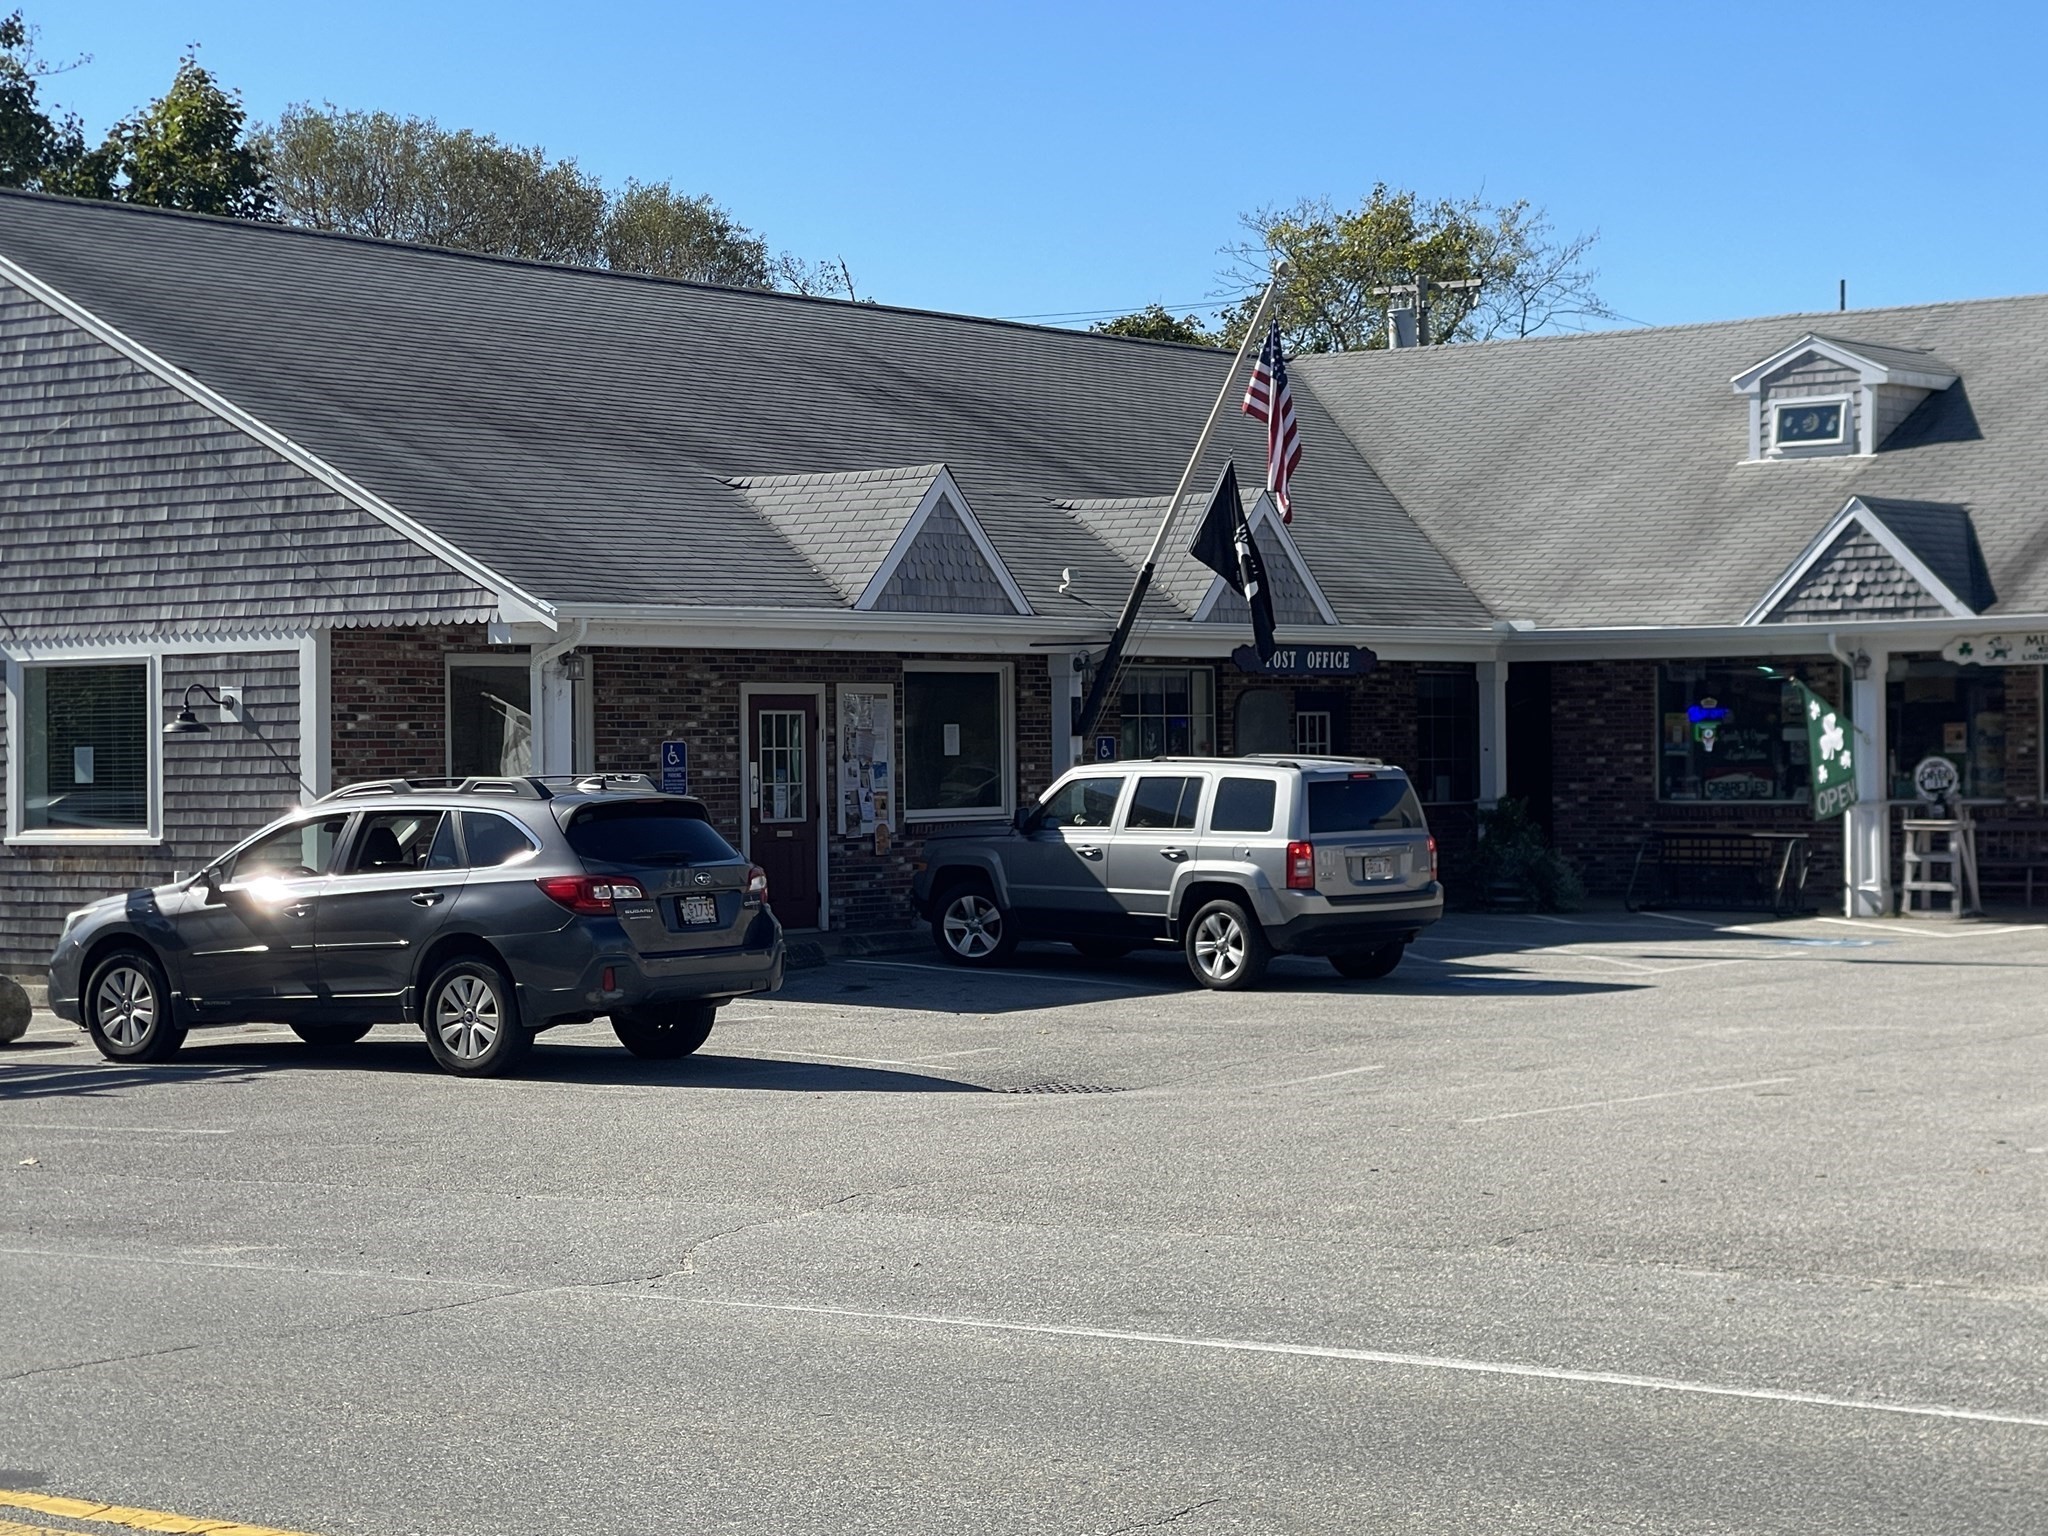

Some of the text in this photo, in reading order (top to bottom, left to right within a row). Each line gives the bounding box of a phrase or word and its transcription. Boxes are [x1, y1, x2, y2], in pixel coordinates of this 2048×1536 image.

[1307, 651, 1350, 669] OFFICE
[1707, 781, 1768, 795] CIGARETES
[1817, 778, 1856, 816] OPEN
